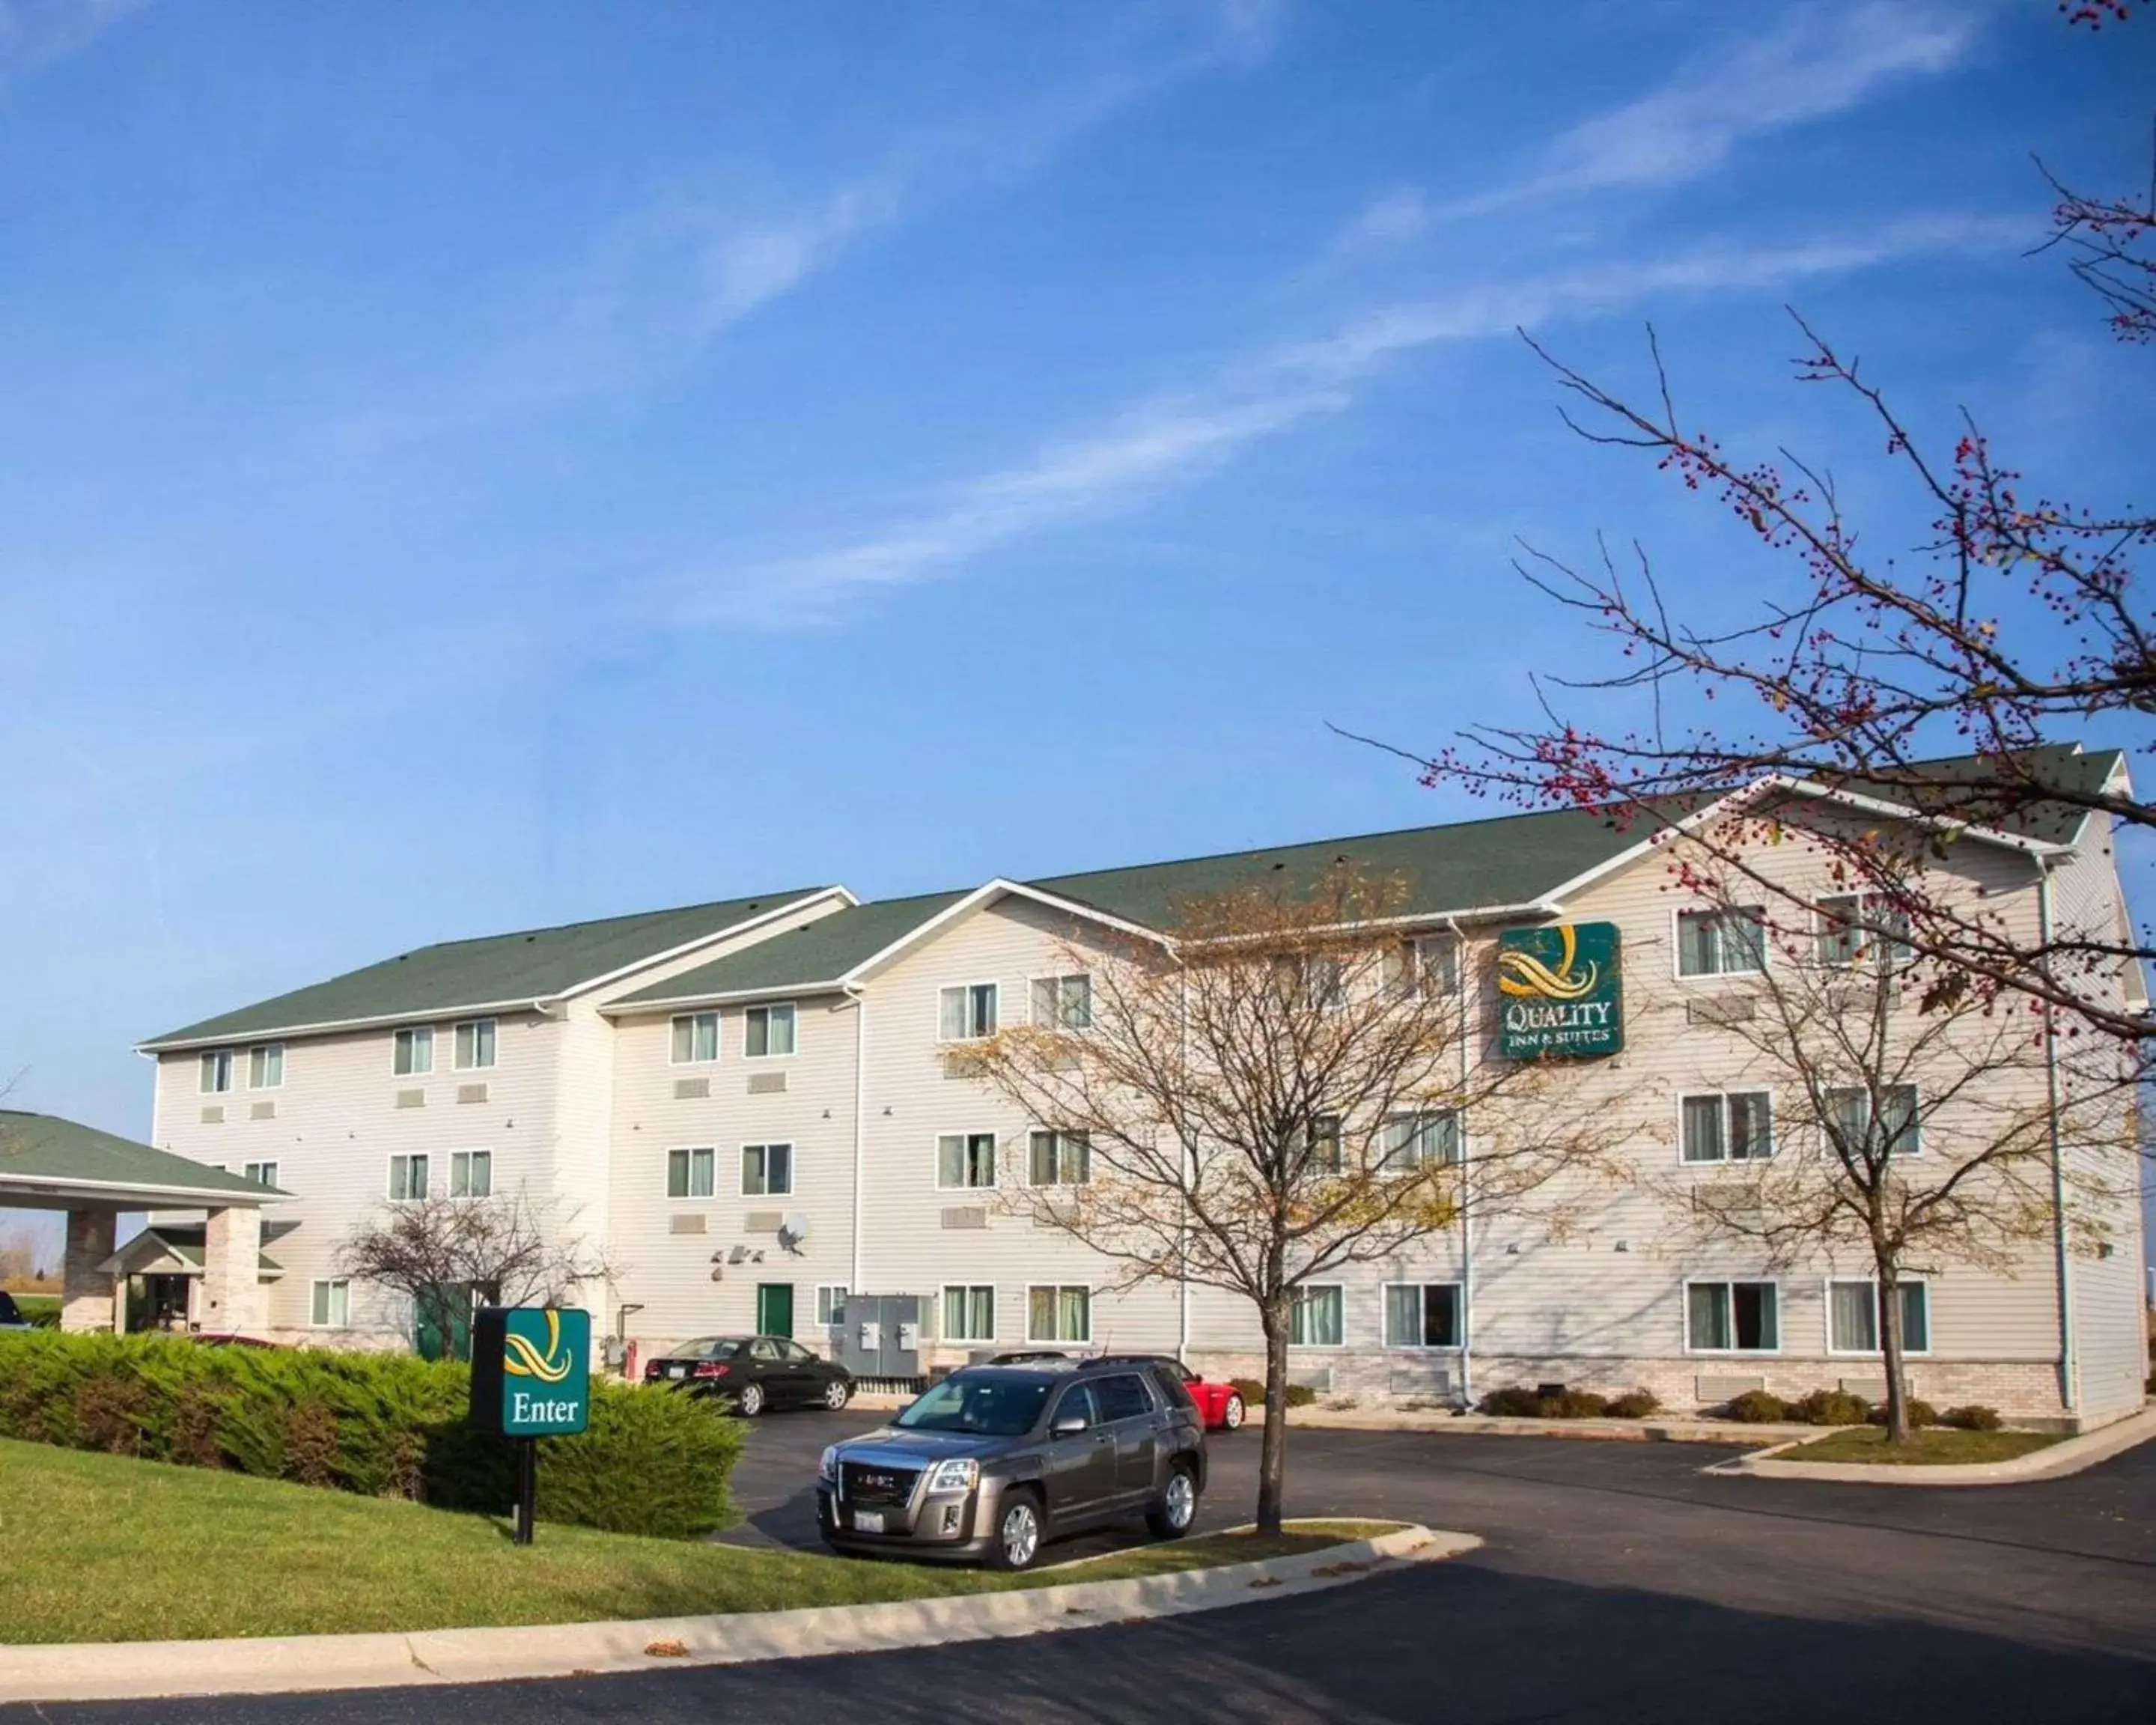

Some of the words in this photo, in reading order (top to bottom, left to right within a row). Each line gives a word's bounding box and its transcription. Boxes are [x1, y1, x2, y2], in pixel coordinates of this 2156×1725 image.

[1506, 1002, 1611, 1032] QUALITY
[1508, 1034, 1539, 1047] INN
[1542, 1032, 1553, 1045] &
[1555, 1029, 1610, 1044] SUITES
[512, 1393, 579, 1423] Enter
